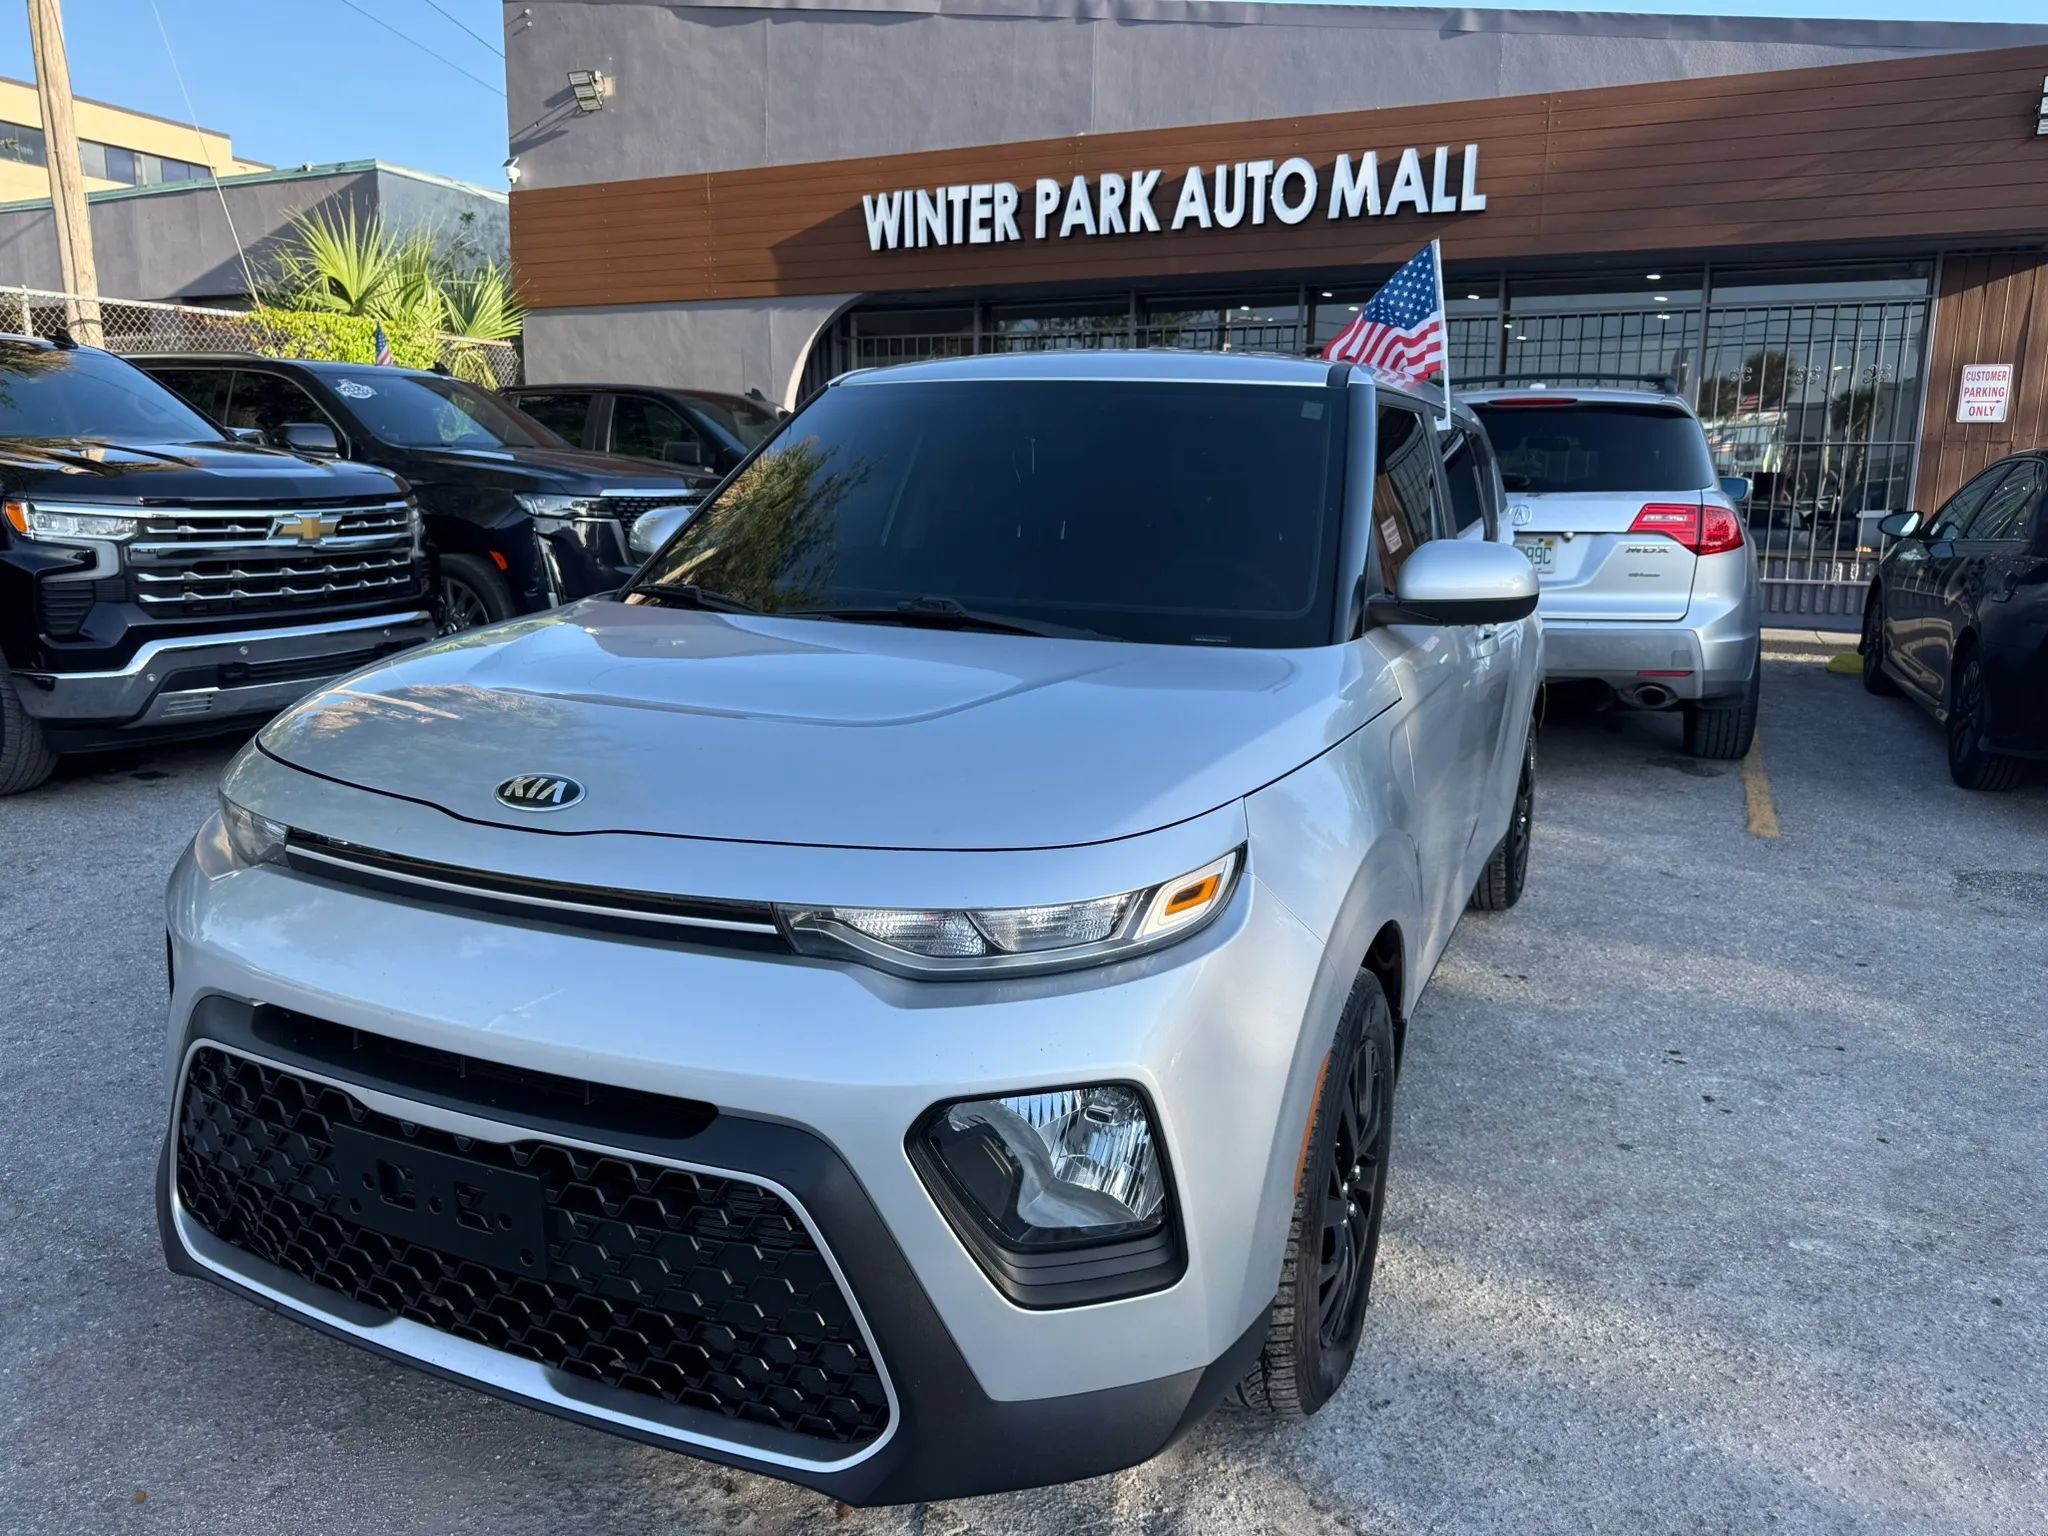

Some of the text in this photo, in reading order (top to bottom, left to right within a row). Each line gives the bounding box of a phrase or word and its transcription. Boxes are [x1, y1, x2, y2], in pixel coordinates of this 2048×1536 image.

[862, 144, 1488, 251] WINTER PARK AUTO MALL
[1965, 370, 2008, 382] CUSTOMER
[1963, 386, 2006, 398] PARKING
[1968, 405, 1996, 417] ONLY
[1624, 545, 1670, 554] MDX
[503, 776, 568, 804] KIA
